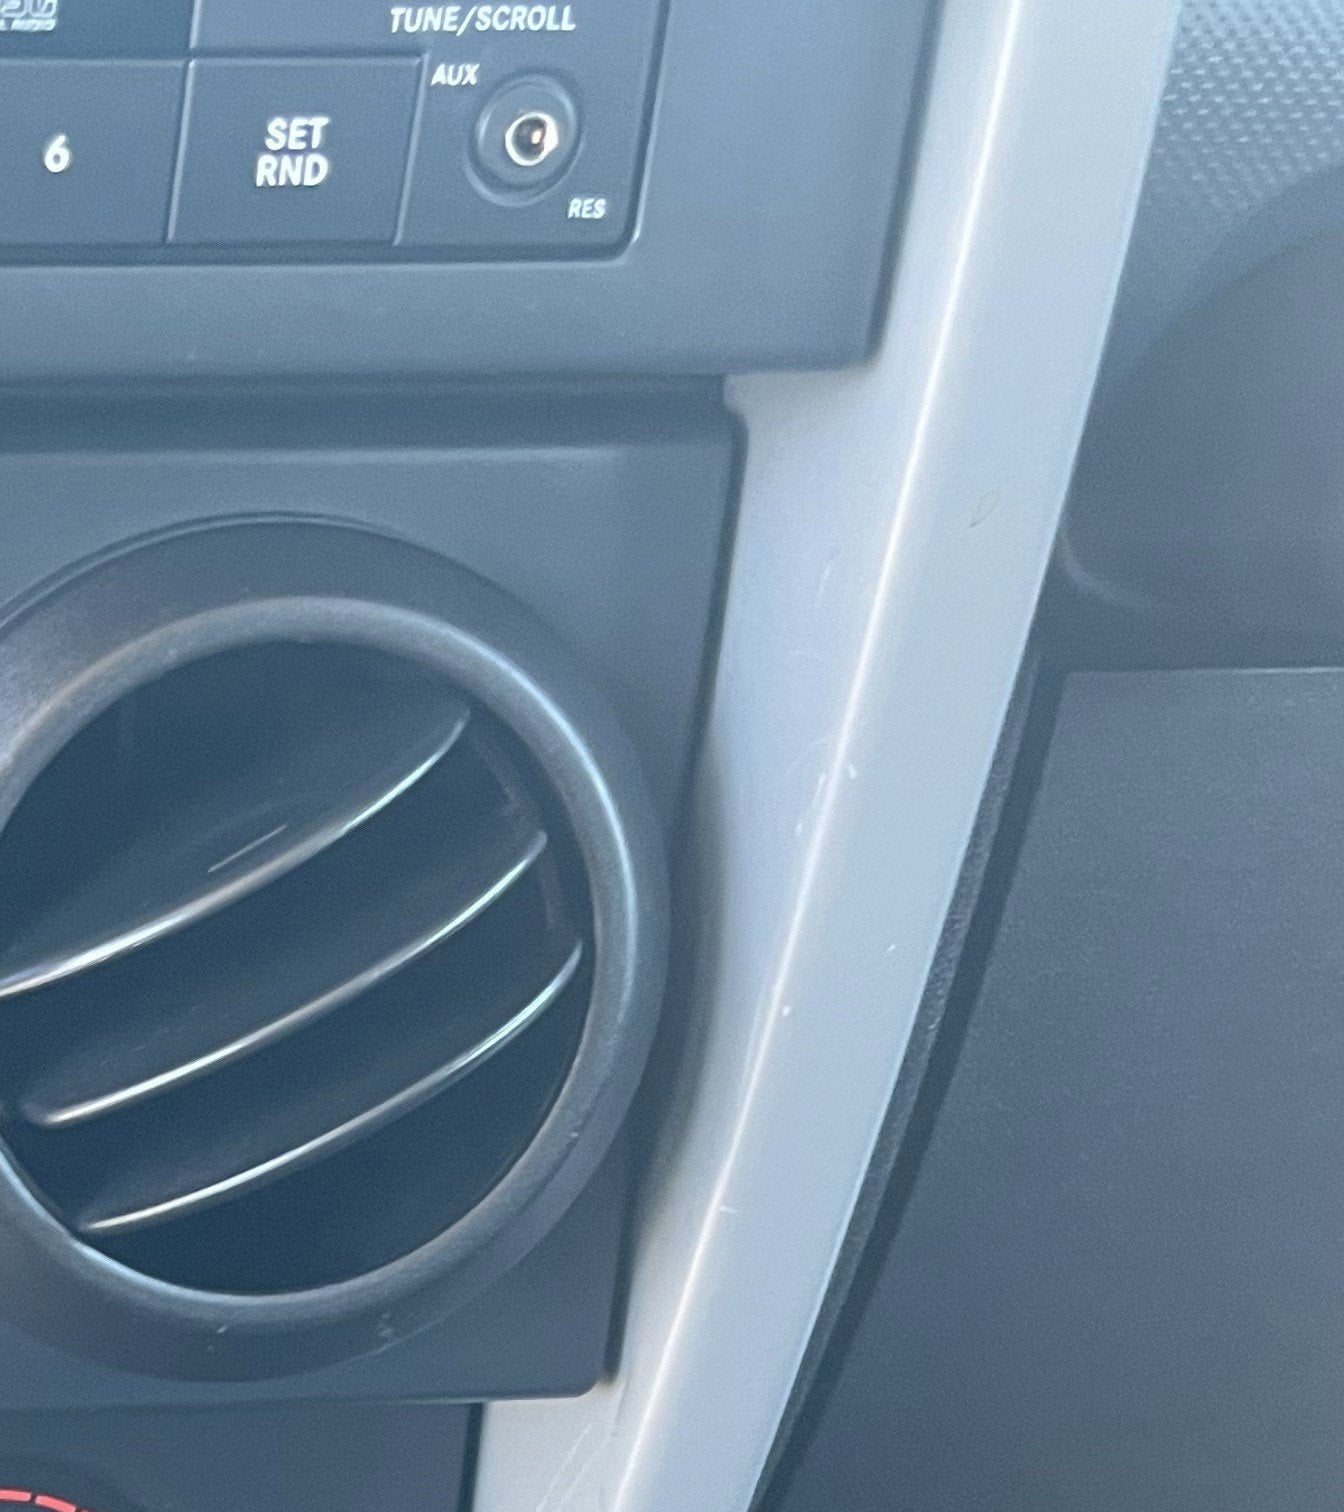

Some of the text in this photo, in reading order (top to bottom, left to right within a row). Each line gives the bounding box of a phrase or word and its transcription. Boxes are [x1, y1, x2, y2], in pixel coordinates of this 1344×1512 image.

[389, 4, 577, 35] TUNE/SCROLL
[430, 63, 480, 86] AUX
[264, 116, 330, 151] SET
[44, 134, 71, 173] 6
[255, 154, 329, 187] RND
[567, 197, 607, 219] RES
